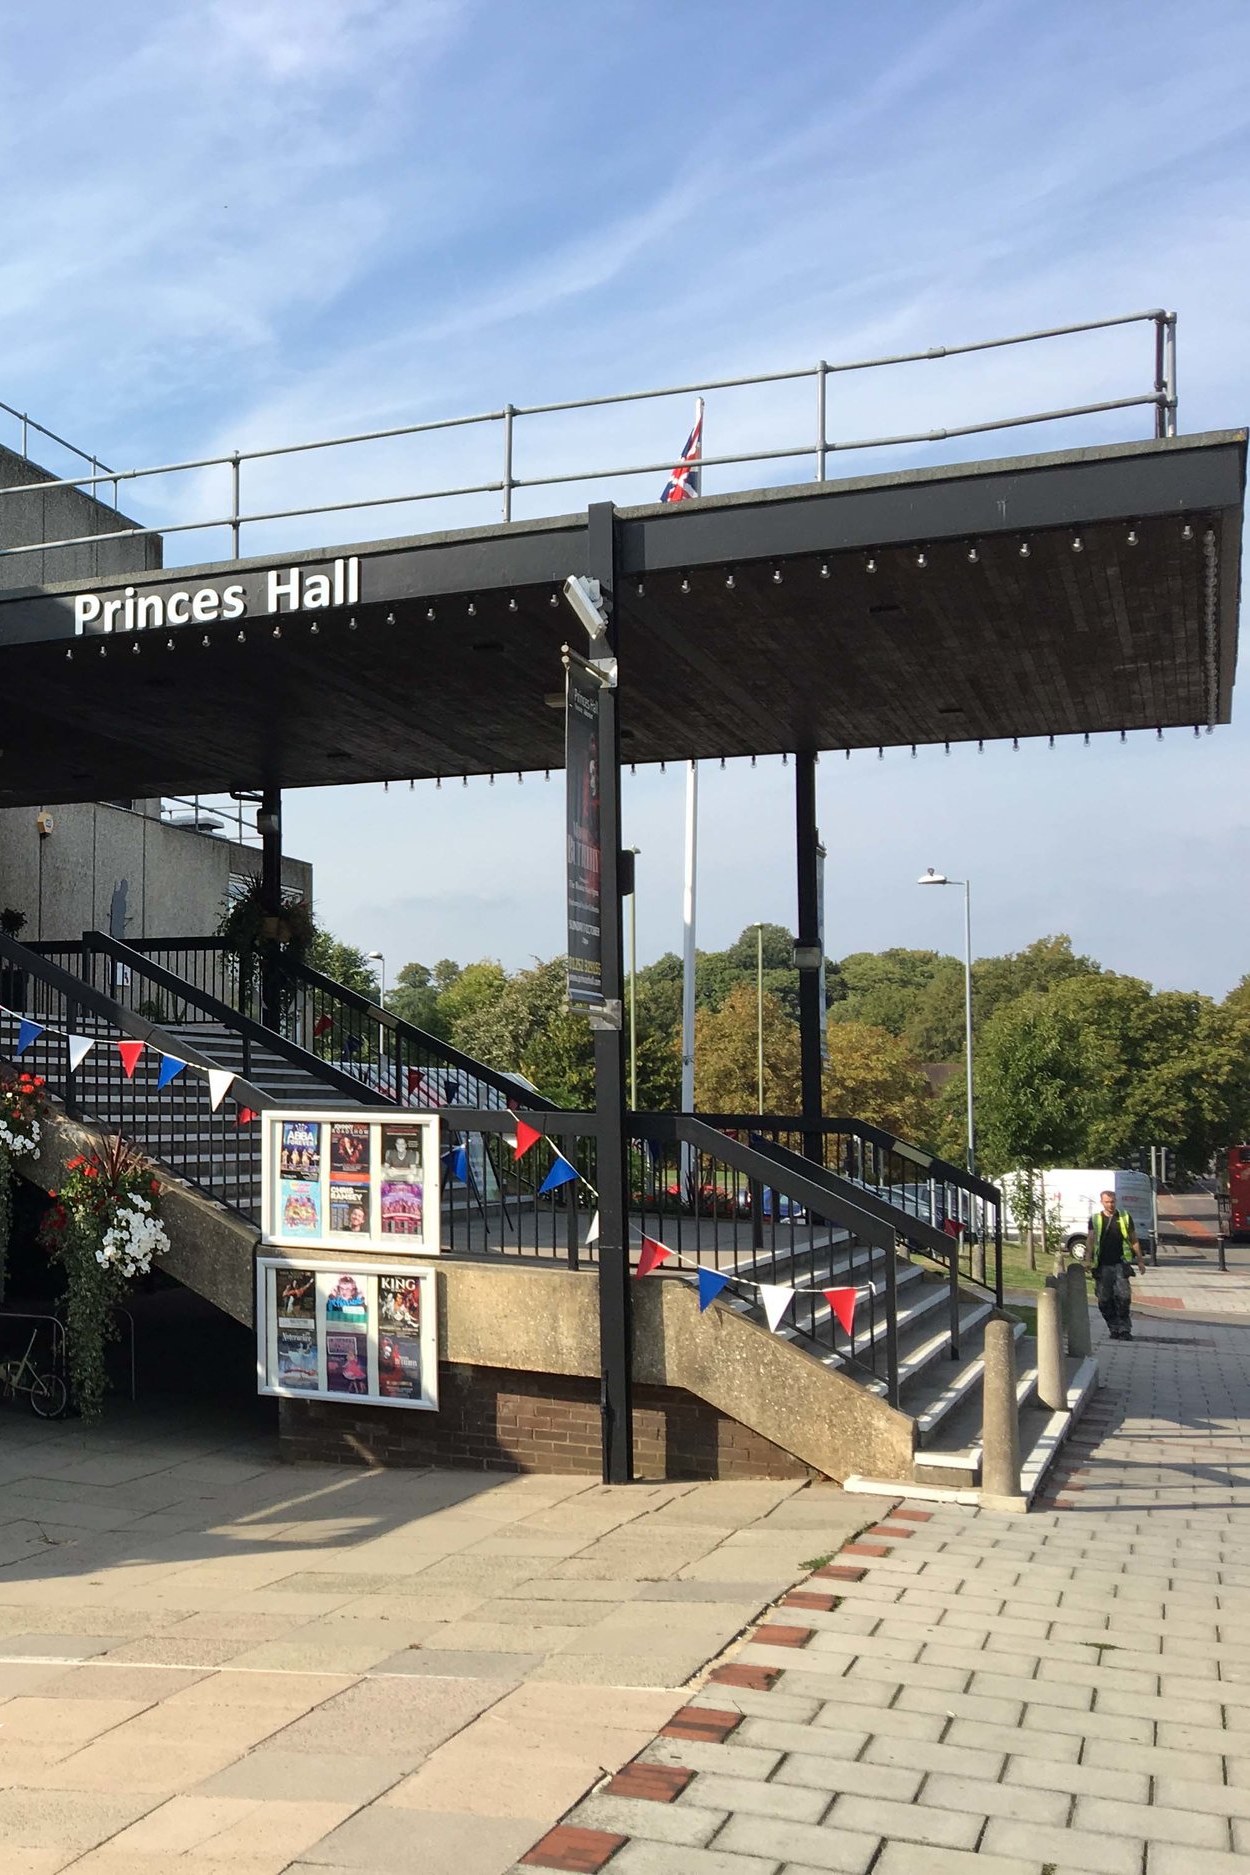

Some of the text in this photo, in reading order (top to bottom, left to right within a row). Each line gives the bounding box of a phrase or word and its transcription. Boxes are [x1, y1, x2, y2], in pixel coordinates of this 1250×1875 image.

[74, 556, 359, 635] Princes Hall
[287, 1132, 314, 1141] ABBA
[331, 1193, 363, 1202] RAMSEY
[381, 1278, 416, 1290] KING
